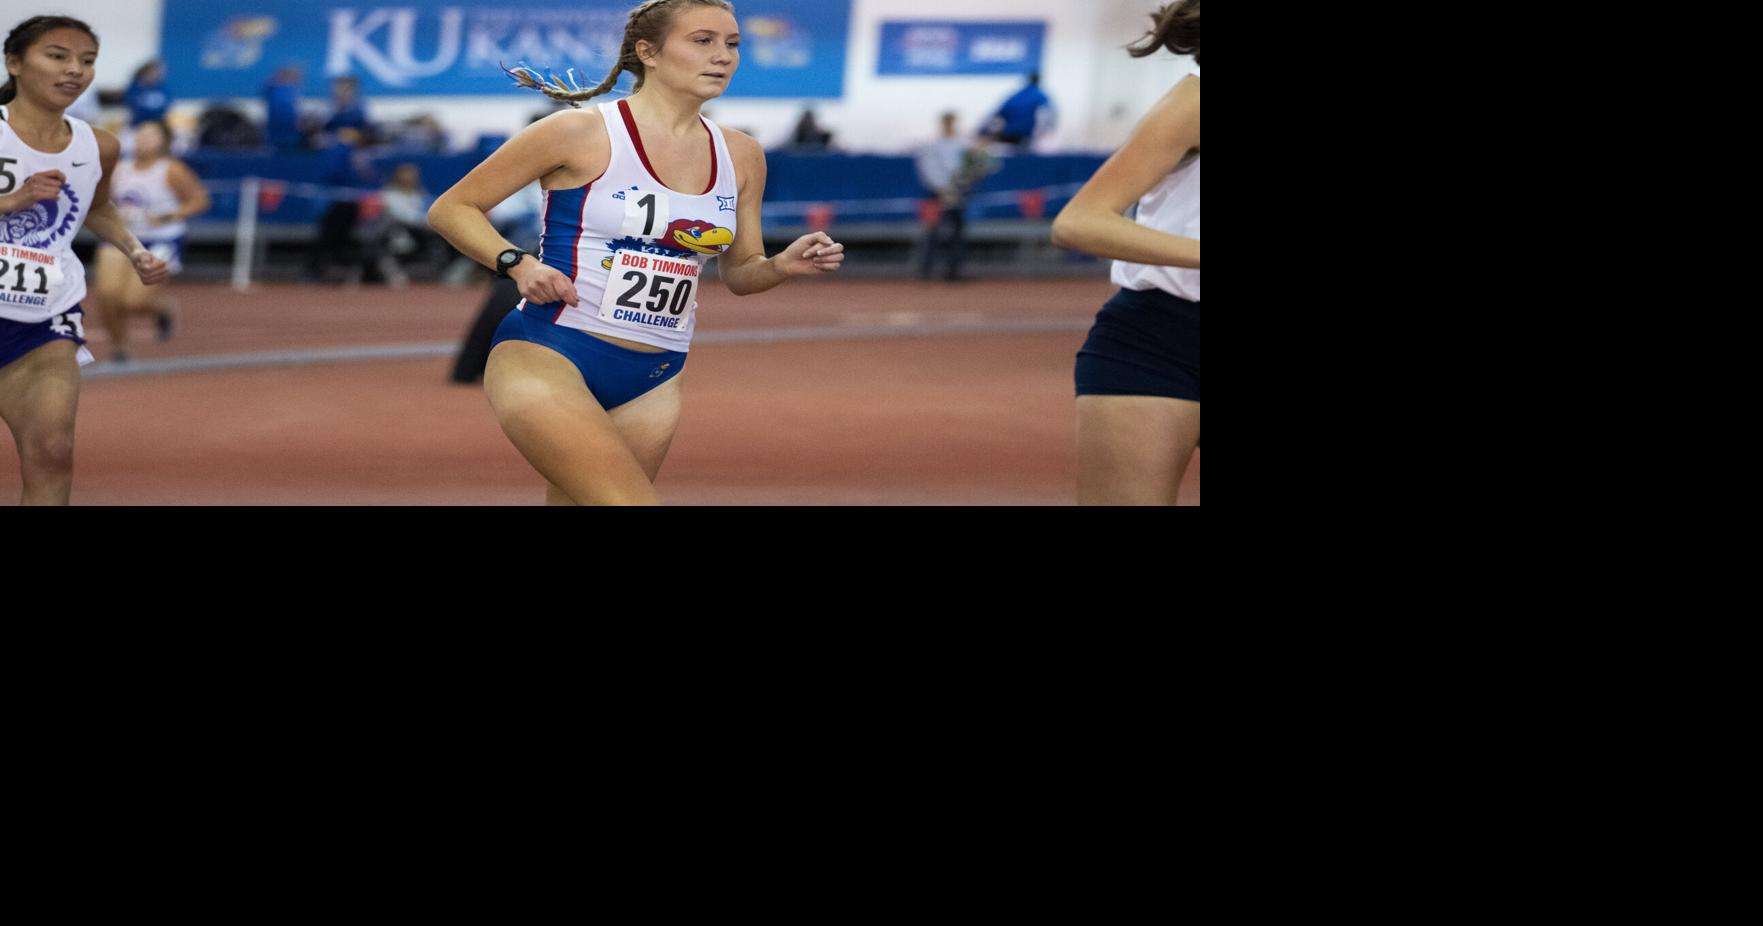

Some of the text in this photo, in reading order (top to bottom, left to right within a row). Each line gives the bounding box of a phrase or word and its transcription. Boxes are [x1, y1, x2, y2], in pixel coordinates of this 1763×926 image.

[325, 7, 463, 86] KU
[0, 157, 17, 194] 5
[637, 194, 655, 235] 1
[12, 247, 55, 265] TIMMONS
[621, 253, 698, 277] BOB TIMMONS
[616, 270, 692, 315] 250
[613, 308, 679, 329] CHALLENGE
